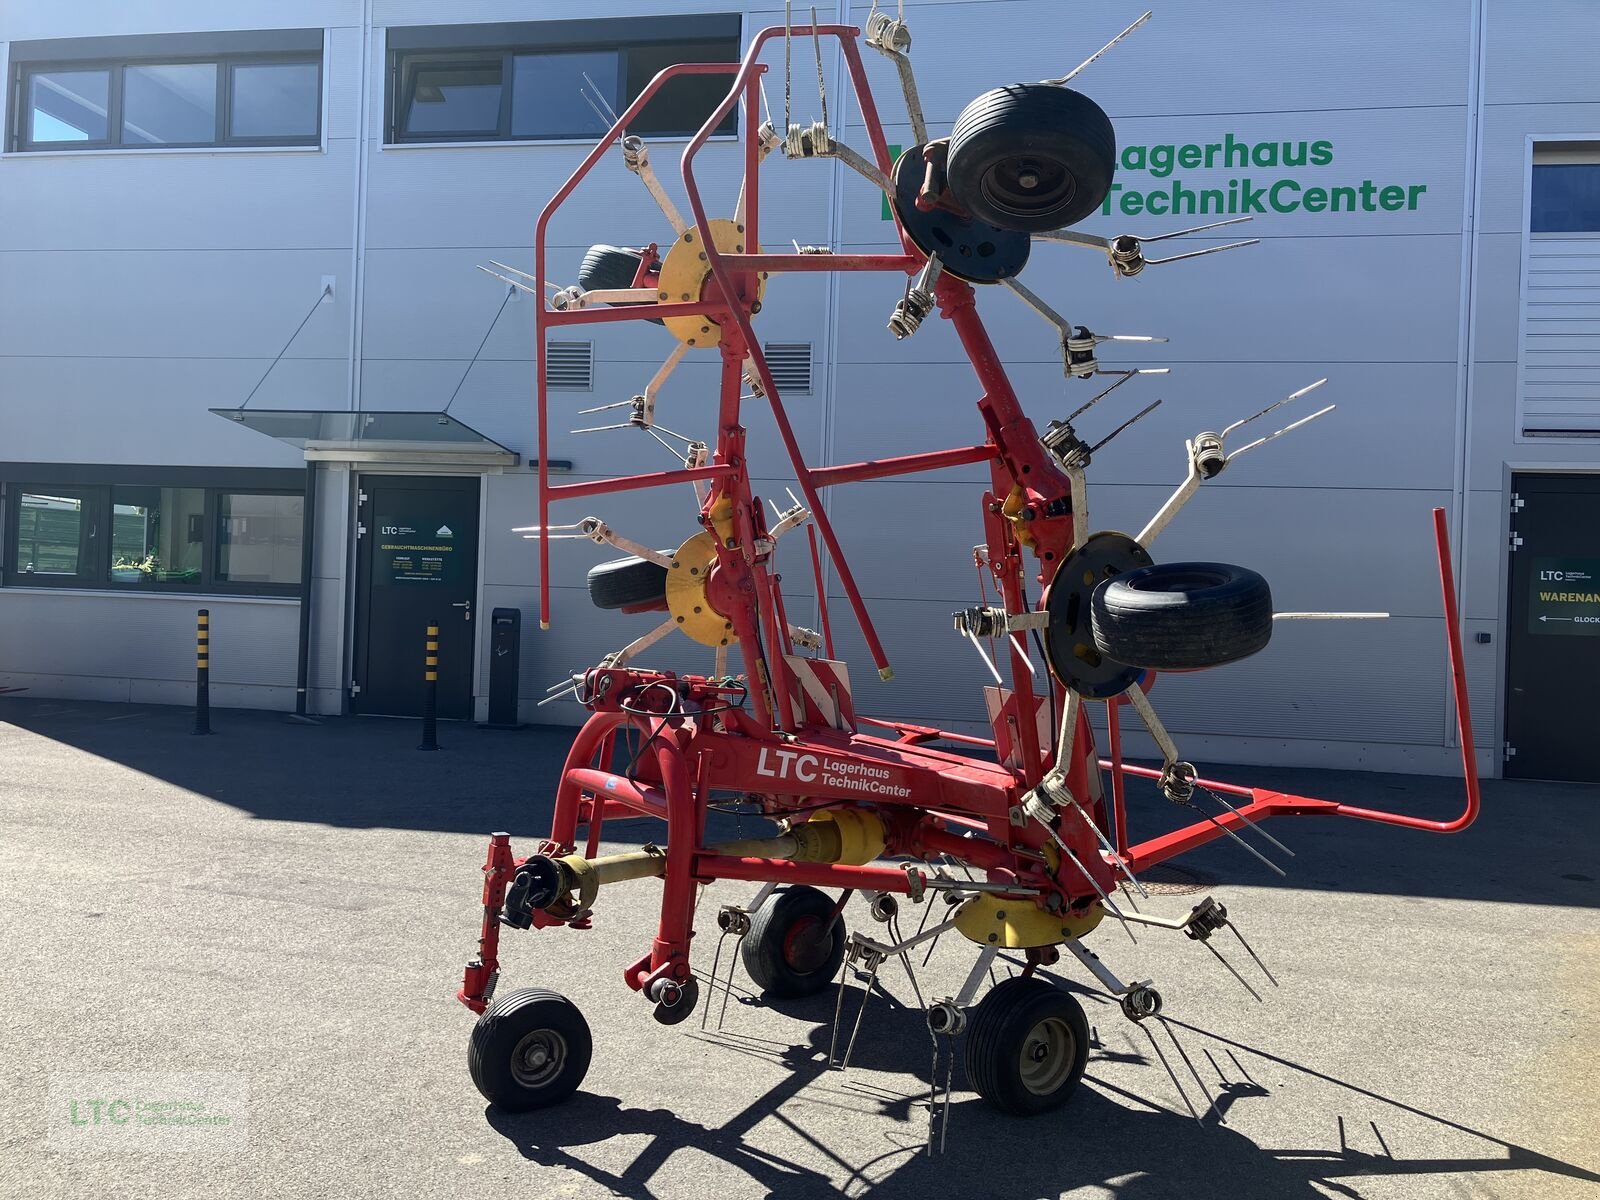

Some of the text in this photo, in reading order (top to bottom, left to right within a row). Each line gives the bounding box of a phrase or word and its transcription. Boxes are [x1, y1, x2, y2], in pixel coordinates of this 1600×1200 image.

[1115, 133, 1333, 178] agerhaus
[381, 526, 398, 535] LTC
[1540, 570, 1564, 581] LTC
[756, 747, 819, 782] LTC
[823, 758, 890, 779] Lagerhaus
[821, 773, 912, 798] TechnikCenter
